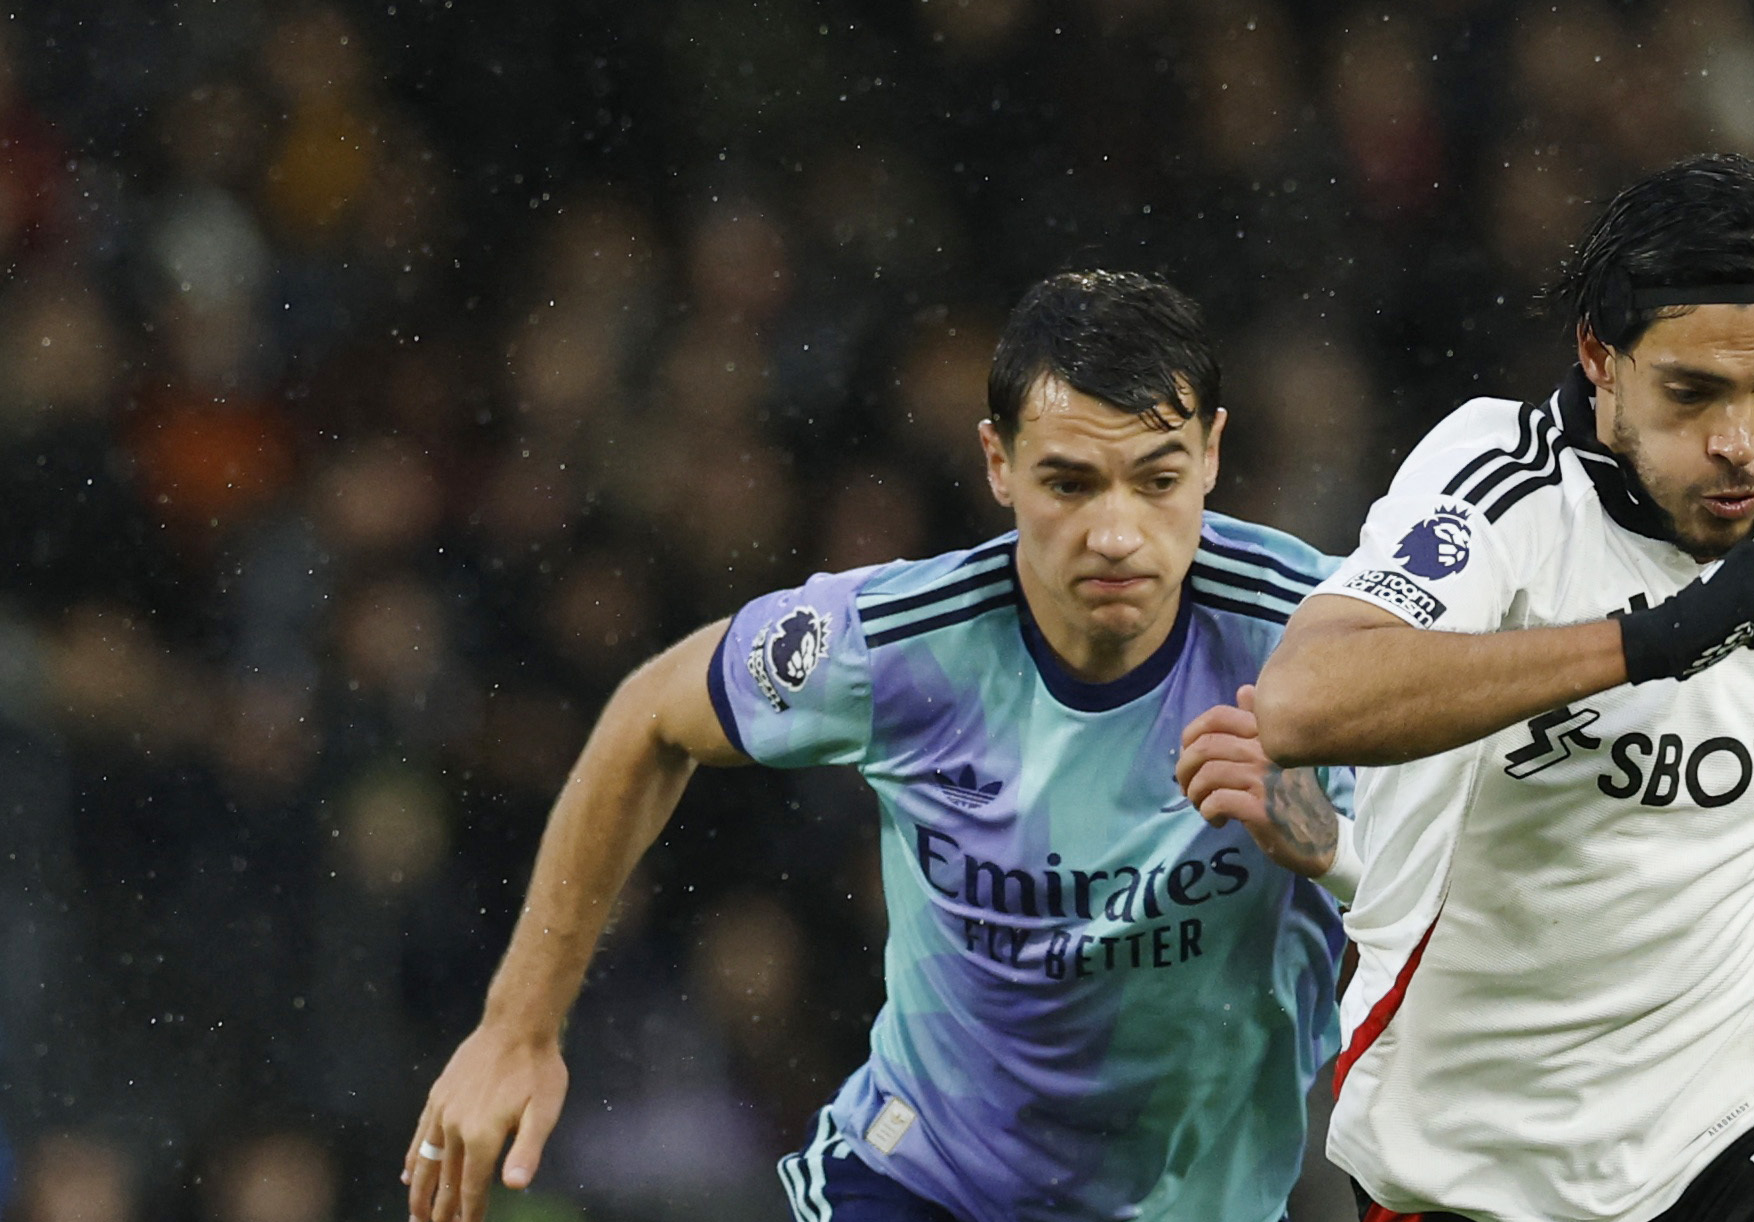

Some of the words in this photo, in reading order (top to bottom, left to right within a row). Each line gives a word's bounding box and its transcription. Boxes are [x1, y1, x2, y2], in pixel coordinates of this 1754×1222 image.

[1371, 585, 1434, 629] racism
[1382, 574, 1436, 613] room
[915, 823, 1249, 923] Emirates
[964, 919, 1031, 969] FLY
[1045, 919, 1204, 980] BETTER
[1708, 1102, 1750, 1136] AEROREADY
